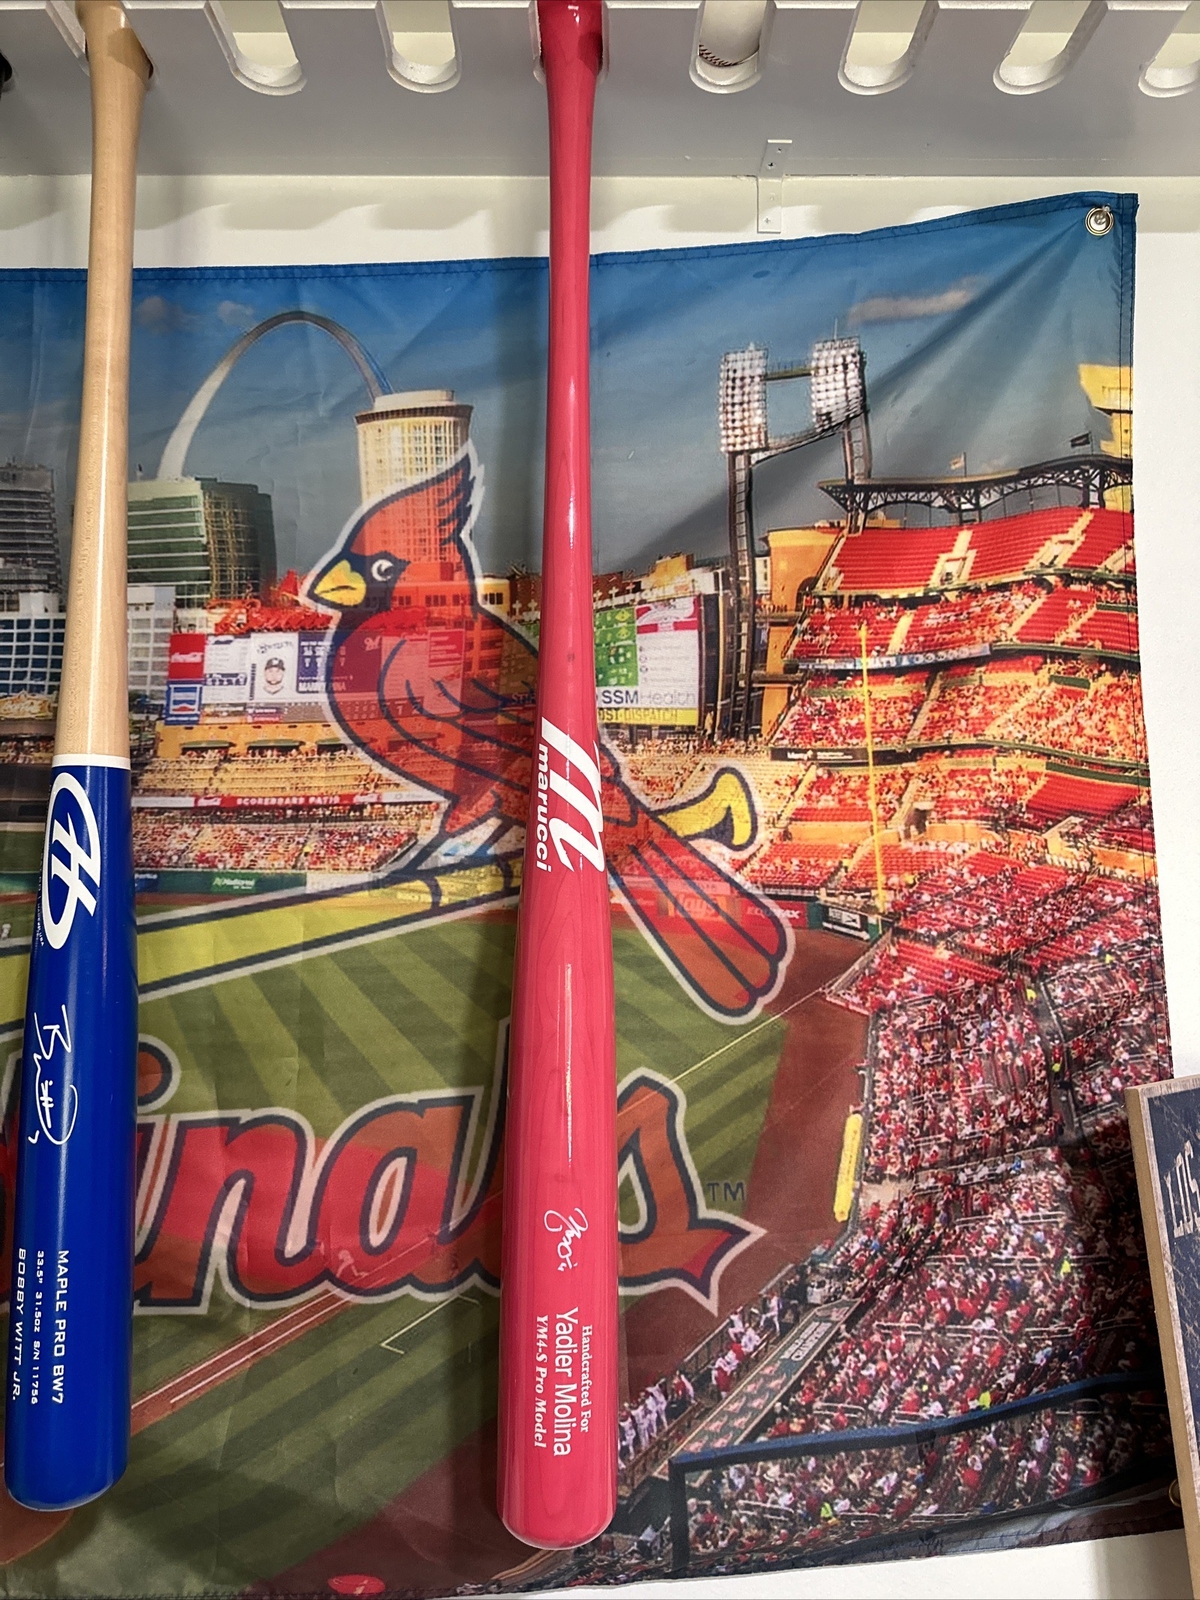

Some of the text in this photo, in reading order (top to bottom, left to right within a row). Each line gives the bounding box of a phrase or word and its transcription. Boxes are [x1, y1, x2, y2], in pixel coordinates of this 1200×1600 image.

[601, 689, 639, 704] SSM
[536, 743, 552, 872] marucci
[706, 1181, 745, 1202] TM
[12, 1248, 27, 1400] BOBBY WITT JR.
[33, 1340, 41, 1360] S/N
[52, 1250, 70, 1403] MAPLE PRO BW7
[534, 1315, 549, 1448] YM4-S Pro Model
[554, 1307, 579, 1456] Yadier Molina
[581, 1325, 593, 1432] Handcrafted For
[31, 1366, 40, 1405] 11756
